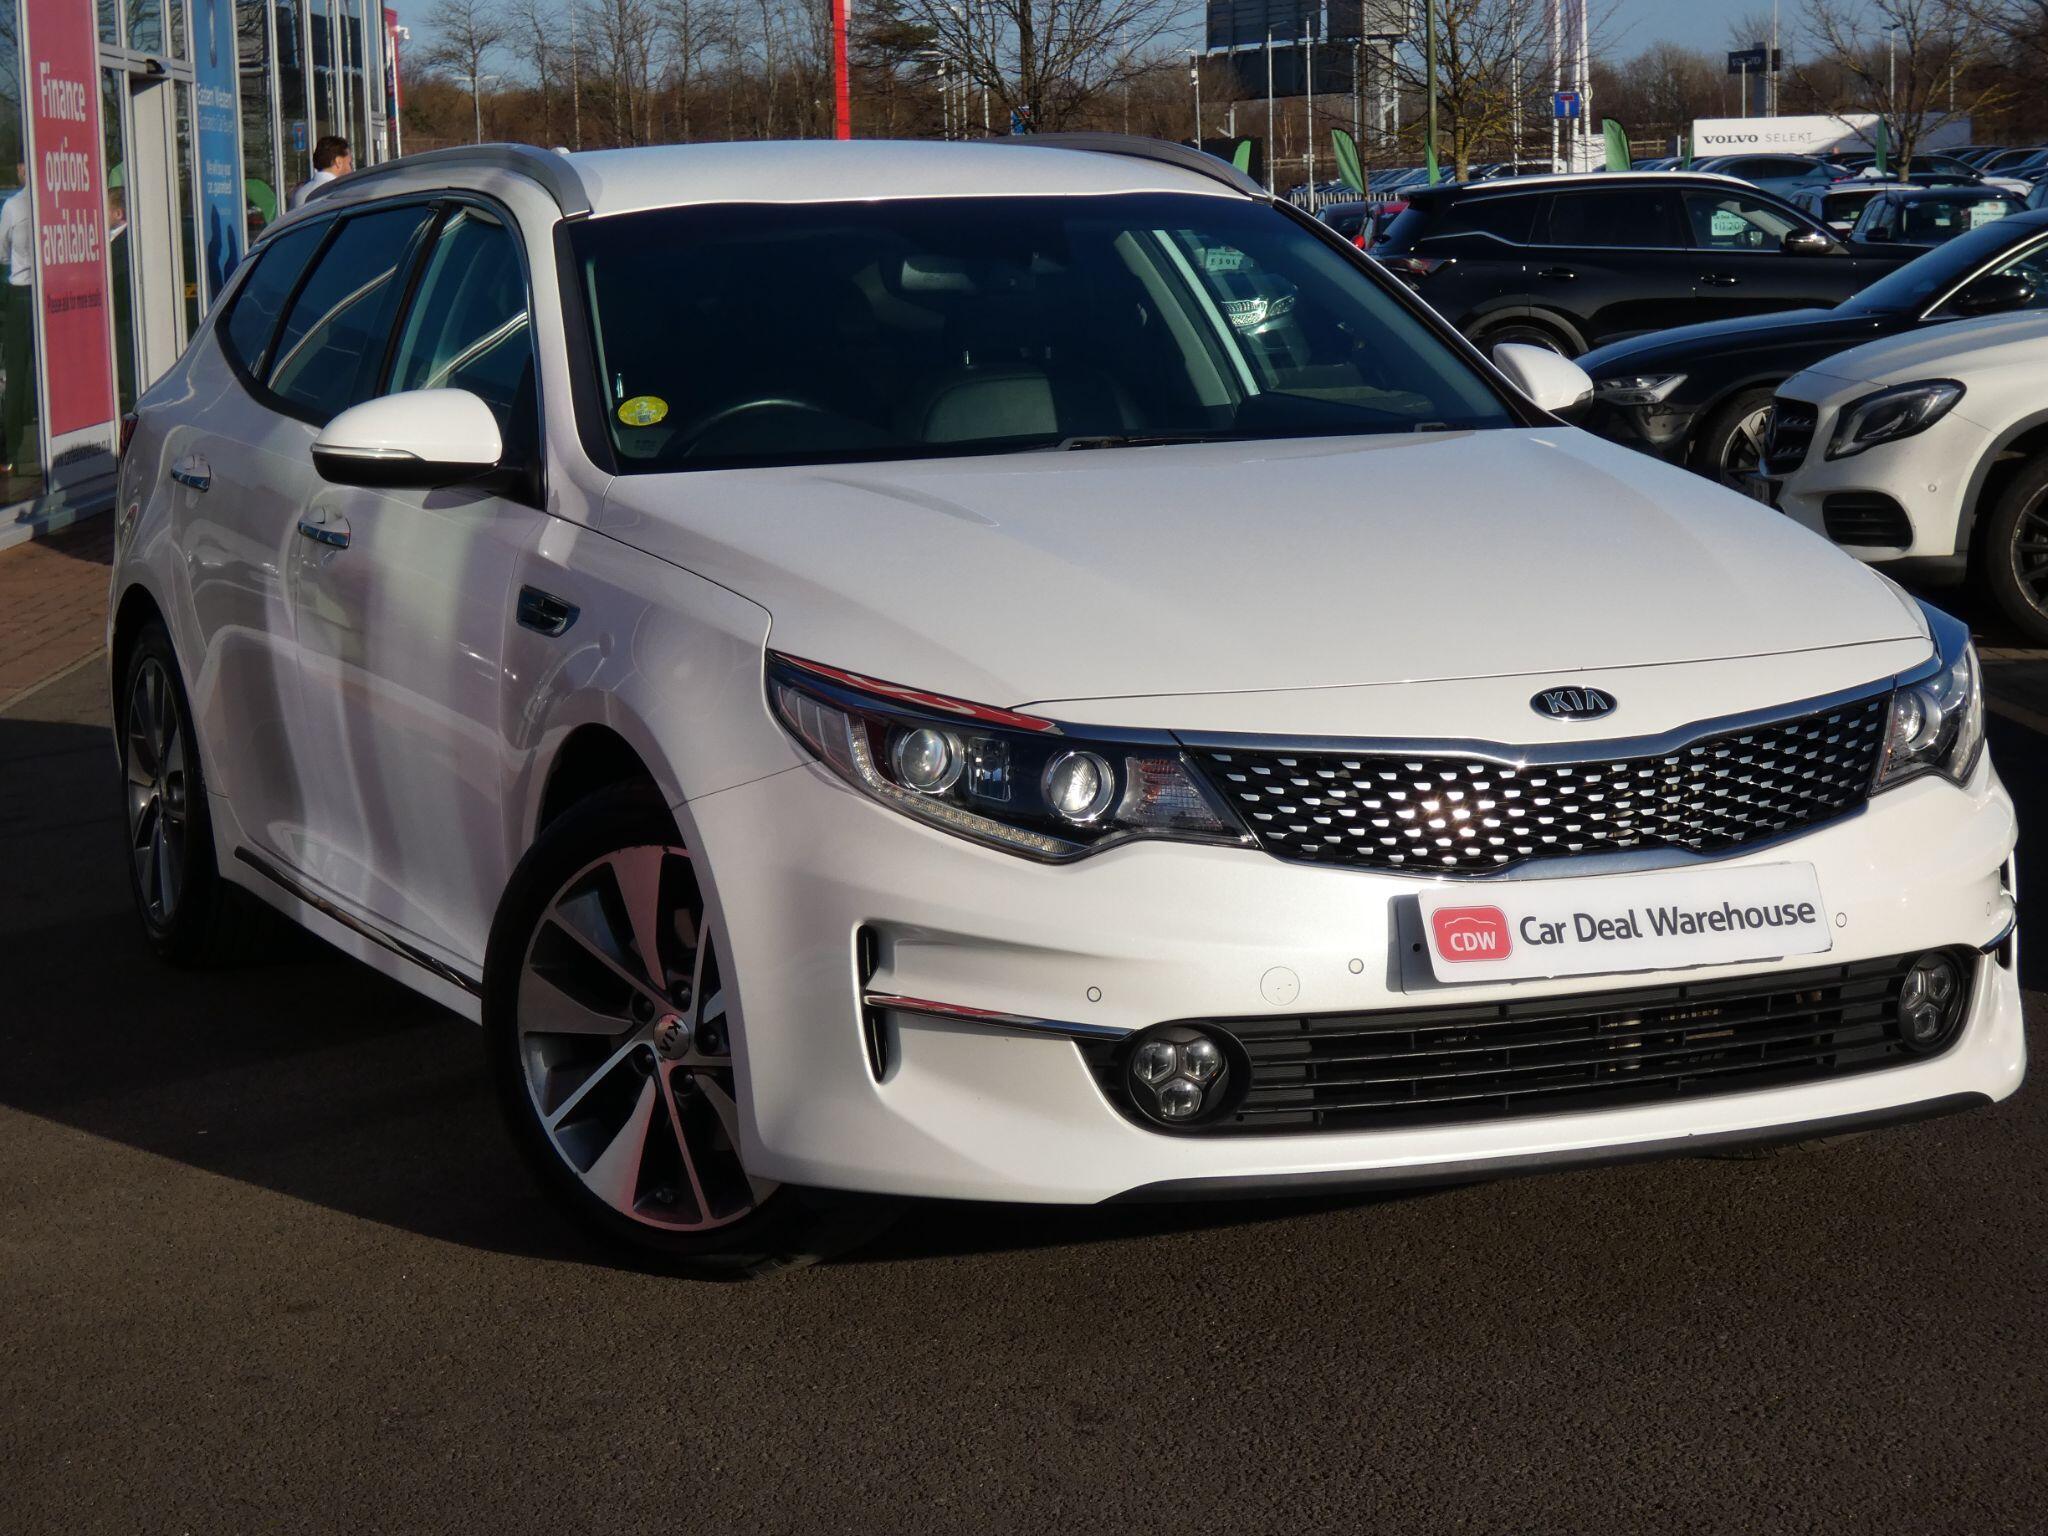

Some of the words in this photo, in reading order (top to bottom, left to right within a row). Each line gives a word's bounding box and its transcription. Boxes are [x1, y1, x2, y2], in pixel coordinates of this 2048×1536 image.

[40, 62, 86, 122] Finance
[1702, 134, 1758, 144] VOLVO
[1765, 132, 1812, 143] SELEKT
[46, 136, 90, 208] options
[43, 209, 100, 266] available!
[1543, 689, 1608, 713] KIA
[1450, 930, 1496, 952] CDW
[1519, 915, 1566, 946] Car
[1574, 908, 1643, 943] Deal
[1645, 901, 1816, 937] Warehouse
